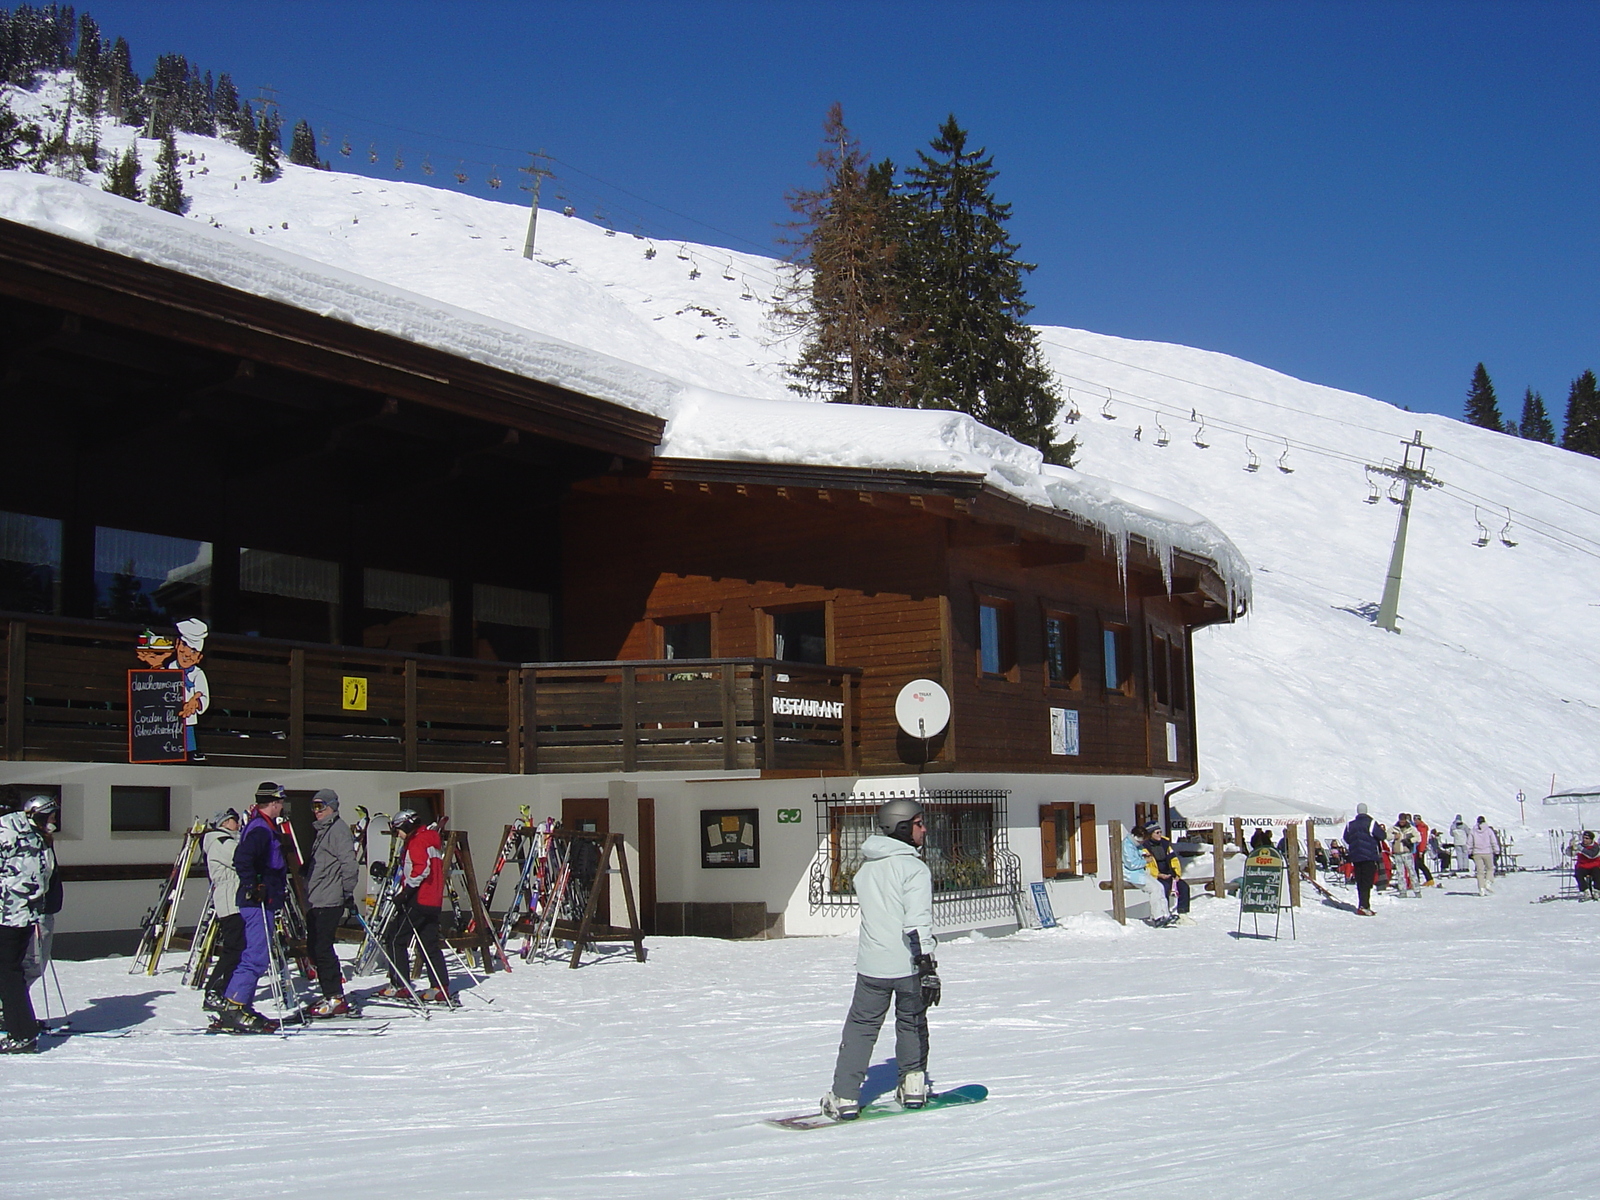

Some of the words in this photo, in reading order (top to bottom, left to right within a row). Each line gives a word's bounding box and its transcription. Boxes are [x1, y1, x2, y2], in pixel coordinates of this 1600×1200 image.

[772, 697, 844, 718] RESTAURANT
[1172, 821, 1187, 829] GER
[1229, 817, 1274, 826] EDINGER
[1255, 856, 1273, 864] Egger
